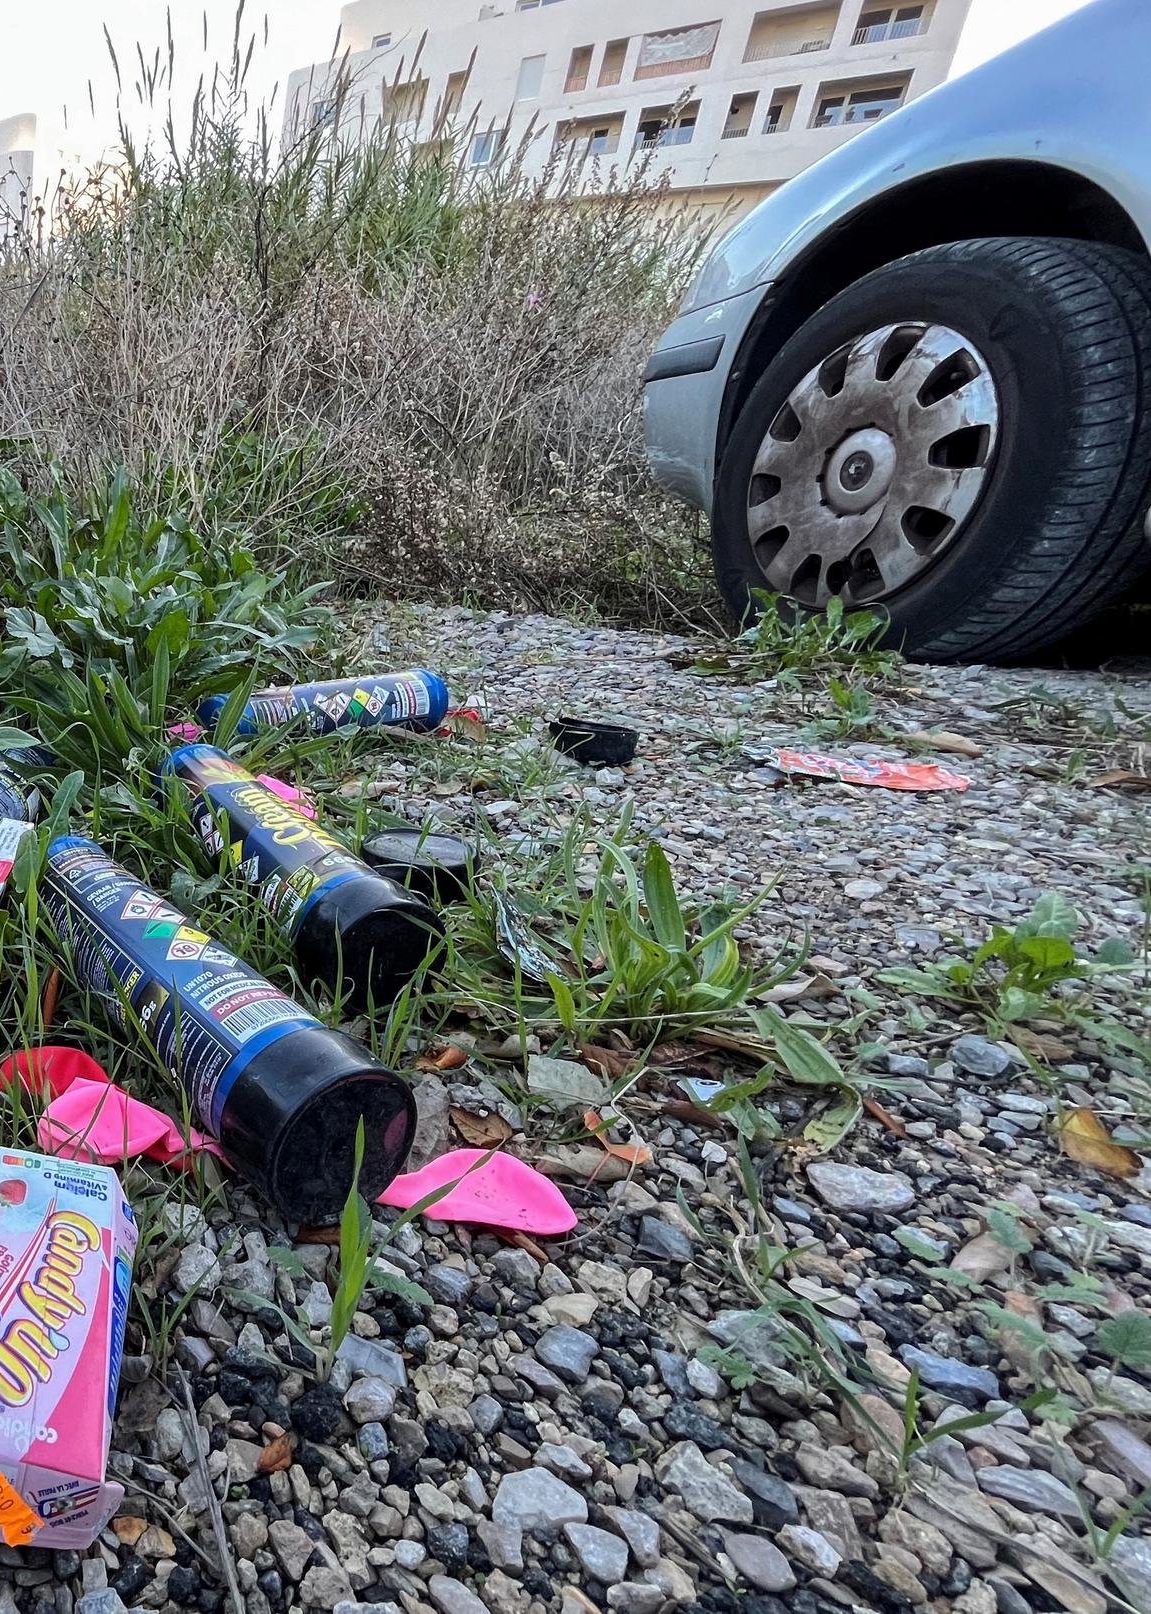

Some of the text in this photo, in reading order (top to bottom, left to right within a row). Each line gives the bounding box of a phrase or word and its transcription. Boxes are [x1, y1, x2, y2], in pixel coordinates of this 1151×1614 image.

[190, 974, 225, 999] NITROUS
[204, 994, 219, 1006] NOT
[217, 987, 232, 998] FOR
[216, 1003, 232, 1015] DO
[231, 993, 251, 1006] NOT
[54, 1180, 108, 1201] Calcium
